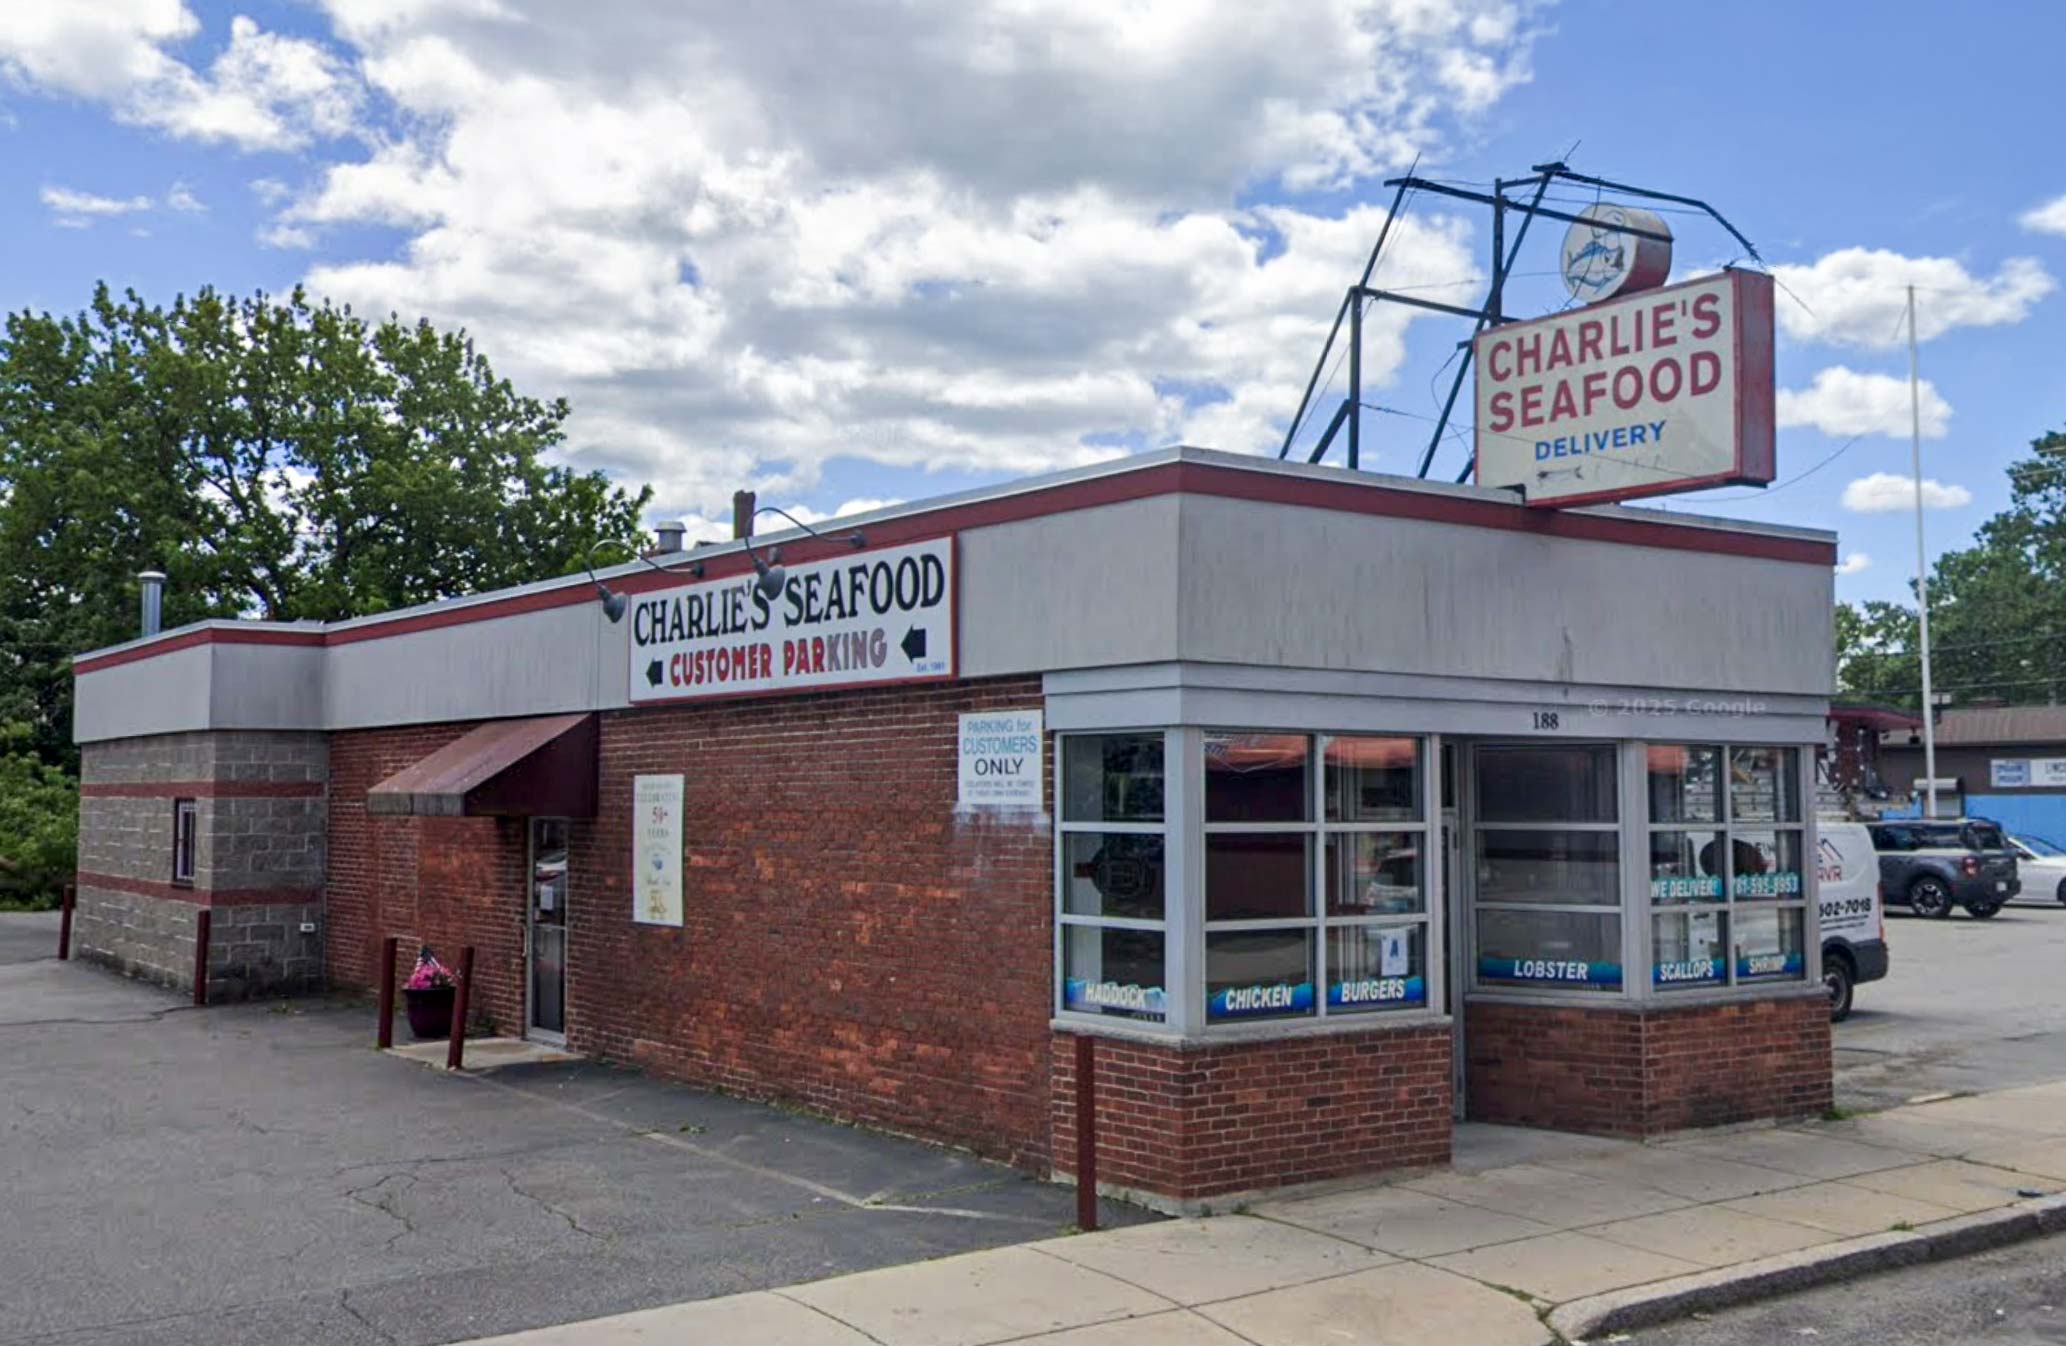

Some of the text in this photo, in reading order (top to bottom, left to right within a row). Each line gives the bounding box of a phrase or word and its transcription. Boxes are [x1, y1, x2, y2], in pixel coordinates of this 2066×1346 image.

[1489, 293, 1721, 382] CHARLIE'S
[1489, 351, 1722, 433] SEAFOOD
[1535, 420, 1667, 461] DELIVERY
[633, 553, 945, 647] CHARLIE'S SEAFOOD
[669, 627, 887, 687] CUSTOMER PARKING
[967, 719, 1013, 733] PARKING
[1532, 711, 1559, 730] 188
[963, 735, 1038, 755] CUSTOMERS
[974, 757, 1024, 776] ONLY
[1650, 879, 1667, 898] WE
[1513, 959, 1588, 981] LOBSTER
[1660, 961, 1714, 981] SCALLOPS
[1085, 982, 1146, 1009] HADDOCK
[1225, 986, 1292, 1011] CHICKEN
[1340, 980, 1405, 1002] BURGERS
